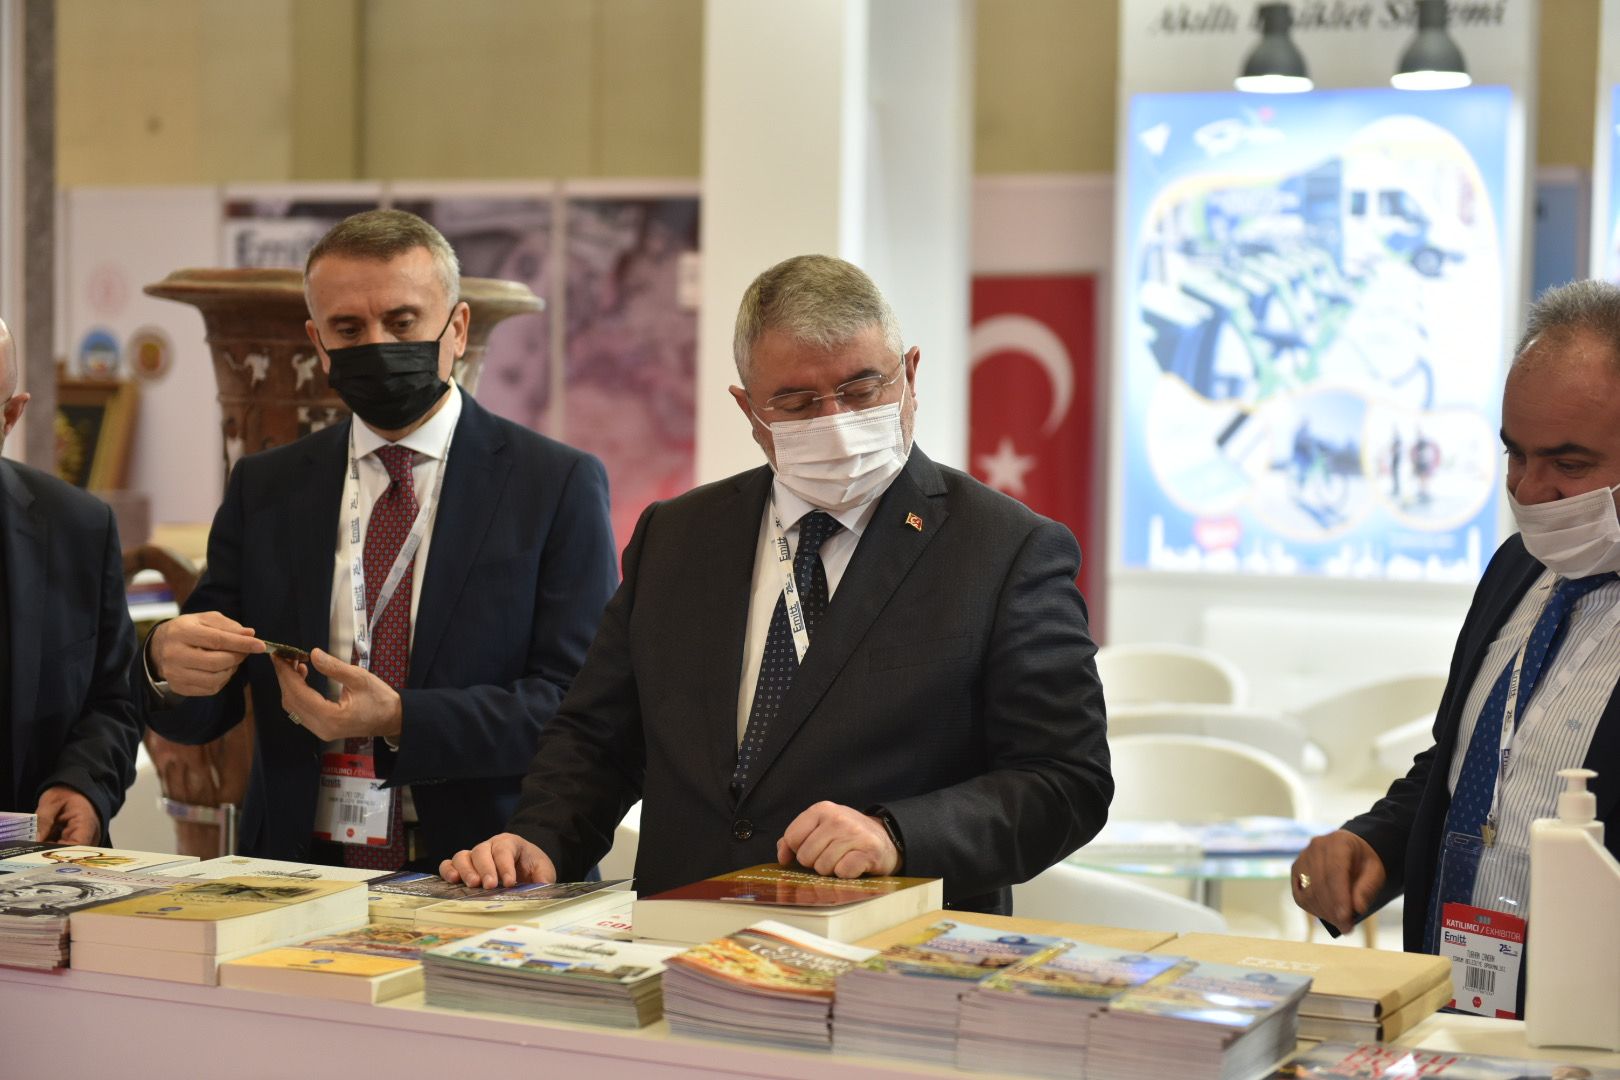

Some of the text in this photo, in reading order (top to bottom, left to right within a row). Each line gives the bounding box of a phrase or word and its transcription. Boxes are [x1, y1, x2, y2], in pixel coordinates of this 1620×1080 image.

[777, 537, 788, 562] Emitt
[789, 604, 802, 634] Emitt
[1444, 931, 1467, 944] Emitt
[1446, 918, 1480, 933] KATILIMCI
[1486, 926, 1521, 940] EXHIBITOR
